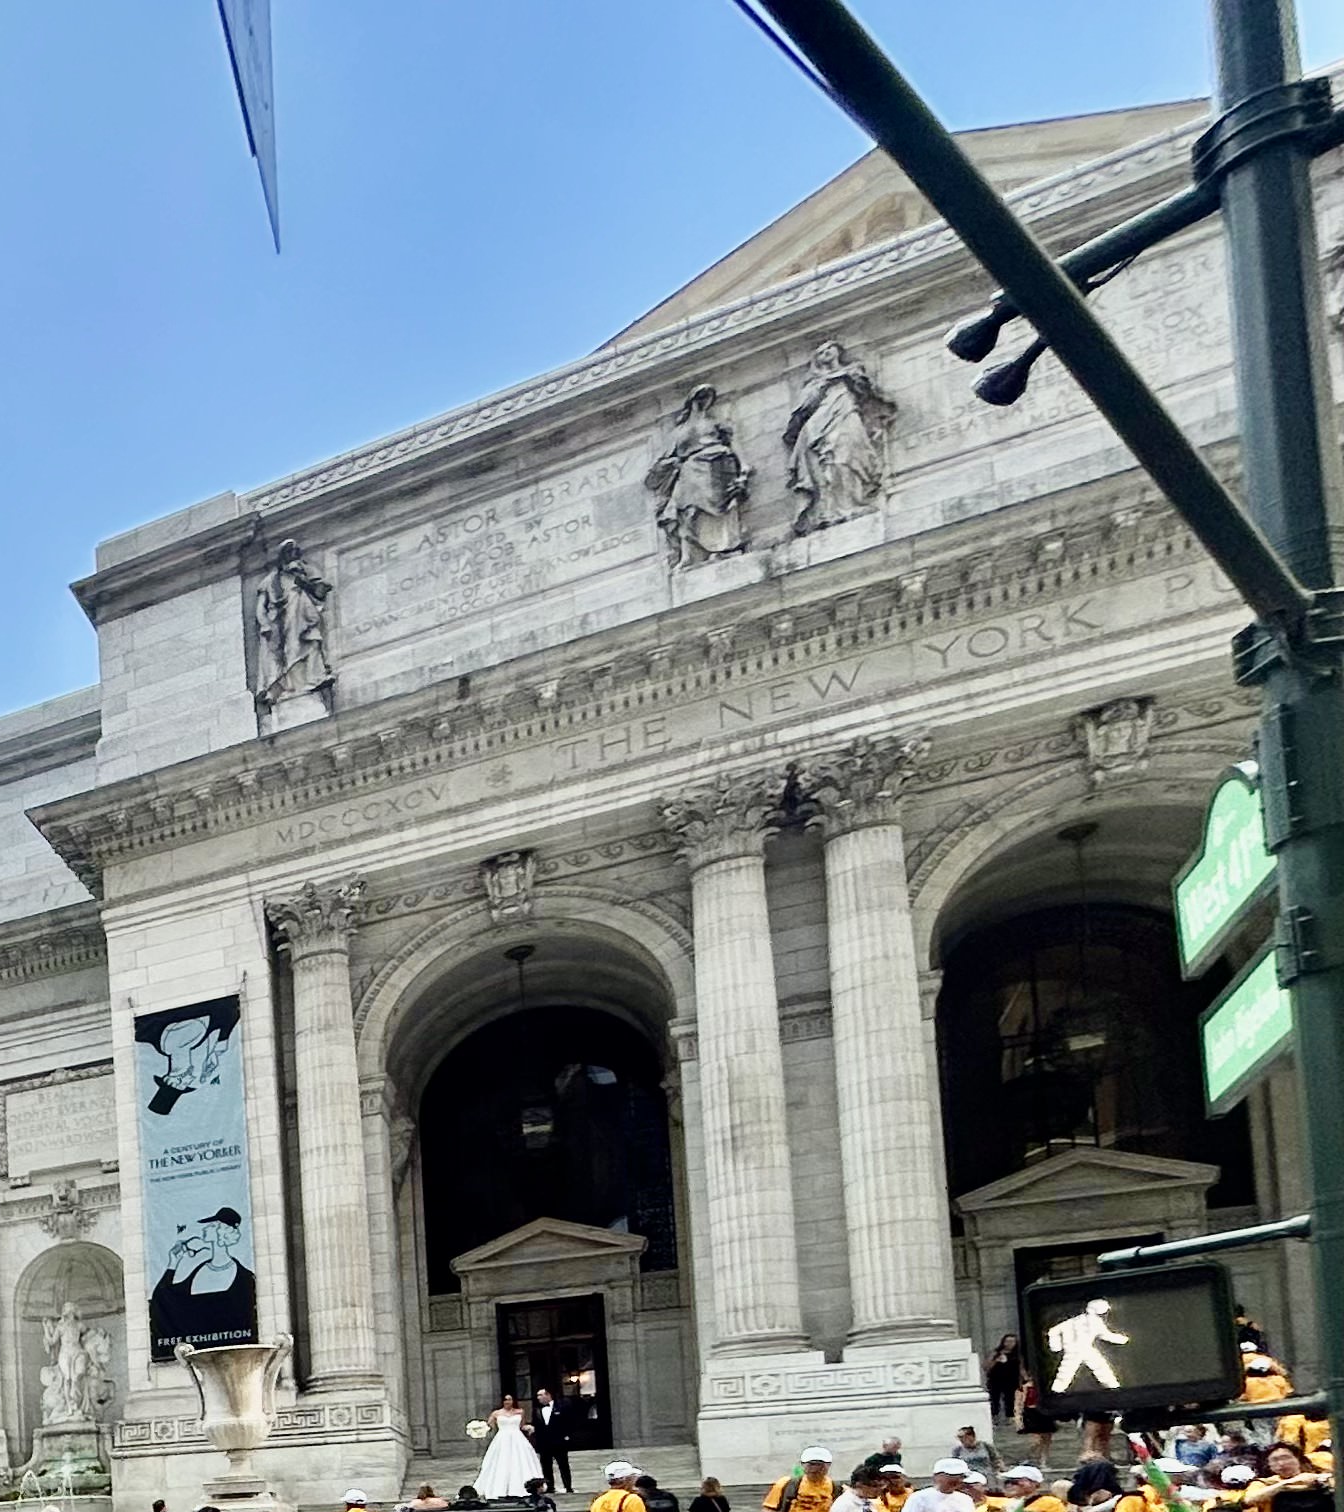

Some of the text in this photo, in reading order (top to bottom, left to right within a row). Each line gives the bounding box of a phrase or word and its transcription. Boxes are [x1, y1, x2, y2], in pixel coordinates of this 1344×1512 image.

[416, 508, 500, 553] ASTOR
[512, 459, 629, 517] LIBRARY
[528, 515, 592, 549] ASTOR
[274, 599, 1107, 846] MDCCCXCV THE NEW YORK
[149, 1144, 242, 1169] THE NEW YORKER
[170, 1141, 212, 1155] CENTURY
[158, 1329, 252, 1347] FREE EXHIBITION
